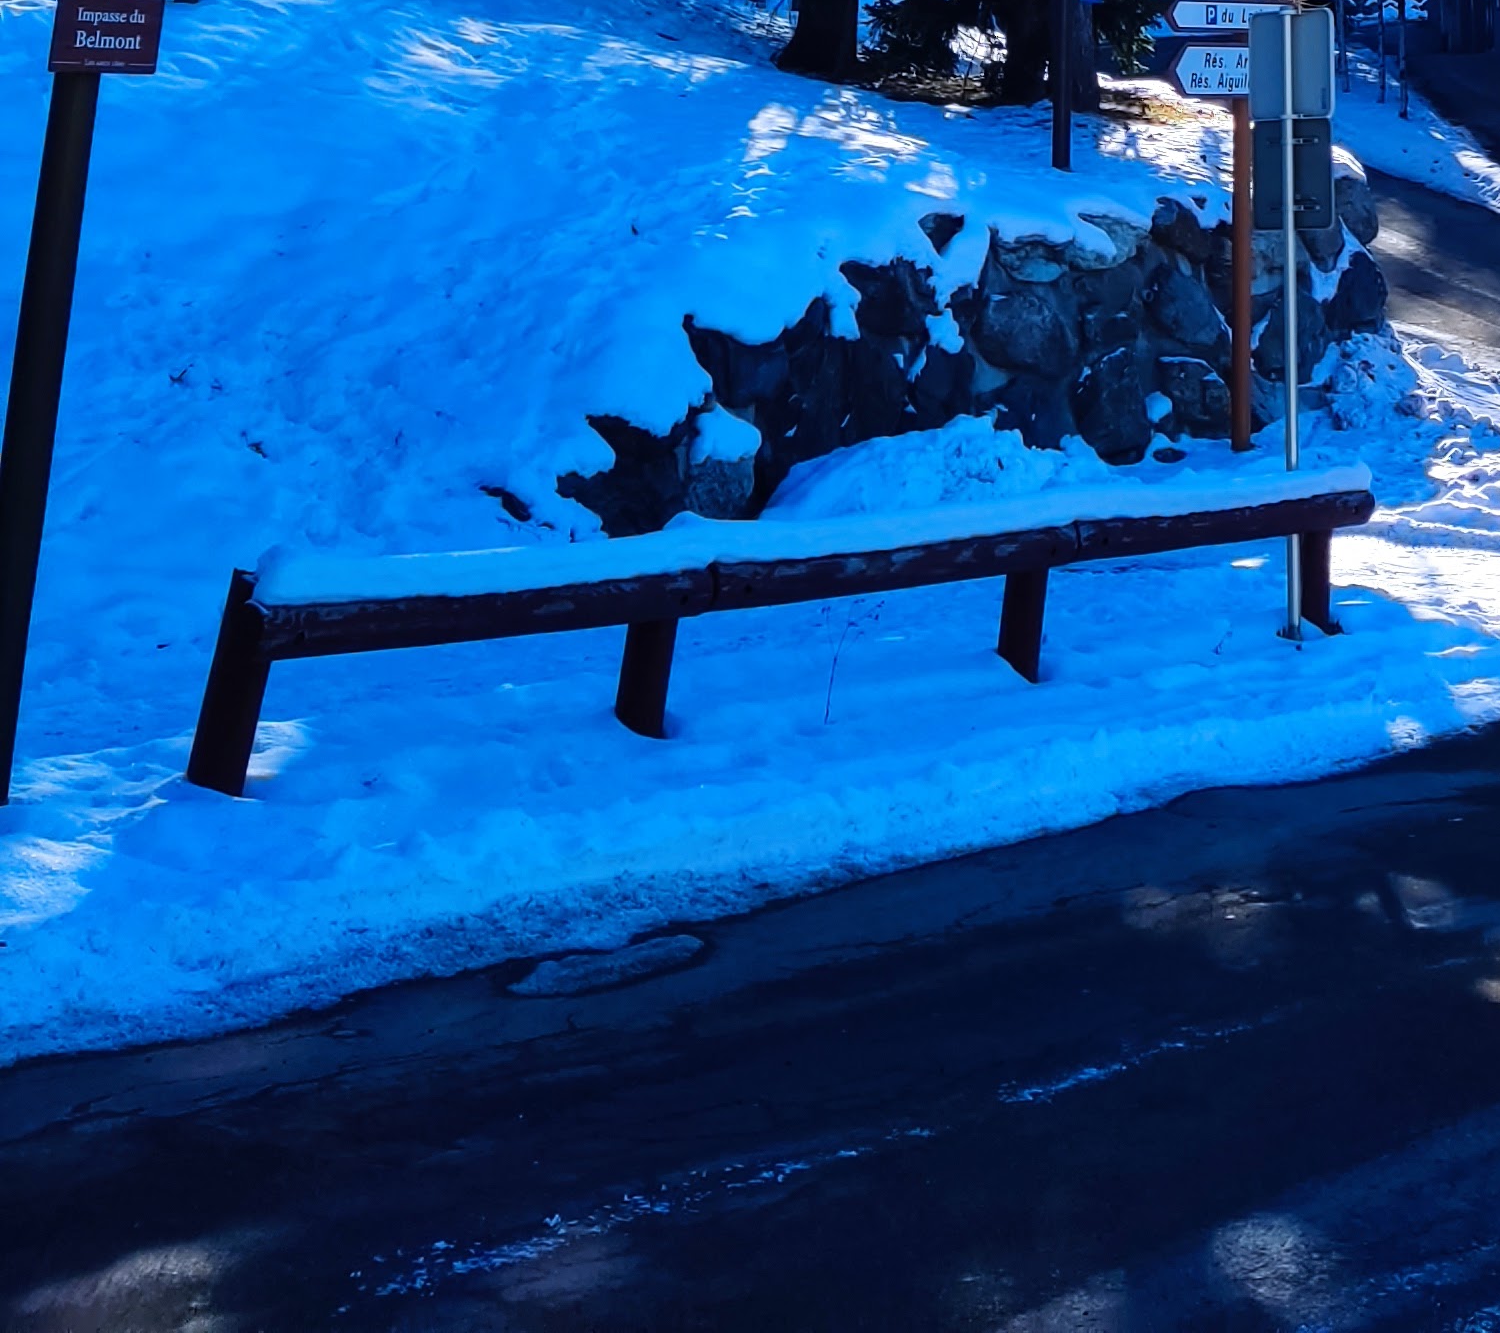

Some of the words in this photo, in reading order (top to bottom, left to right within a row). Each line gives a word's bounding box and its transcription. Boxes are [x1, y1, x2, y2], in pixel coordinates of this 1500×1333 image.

[77, 7, 127, 26] Impasse
[129, 9, 145, 24] du
[1222, 8, 1234, 23] du
[73, 30, 141, 50] Belmont
[1204, 52, 1227, 69] Rés.
[1190, 72, 1212, 89] Rés.
